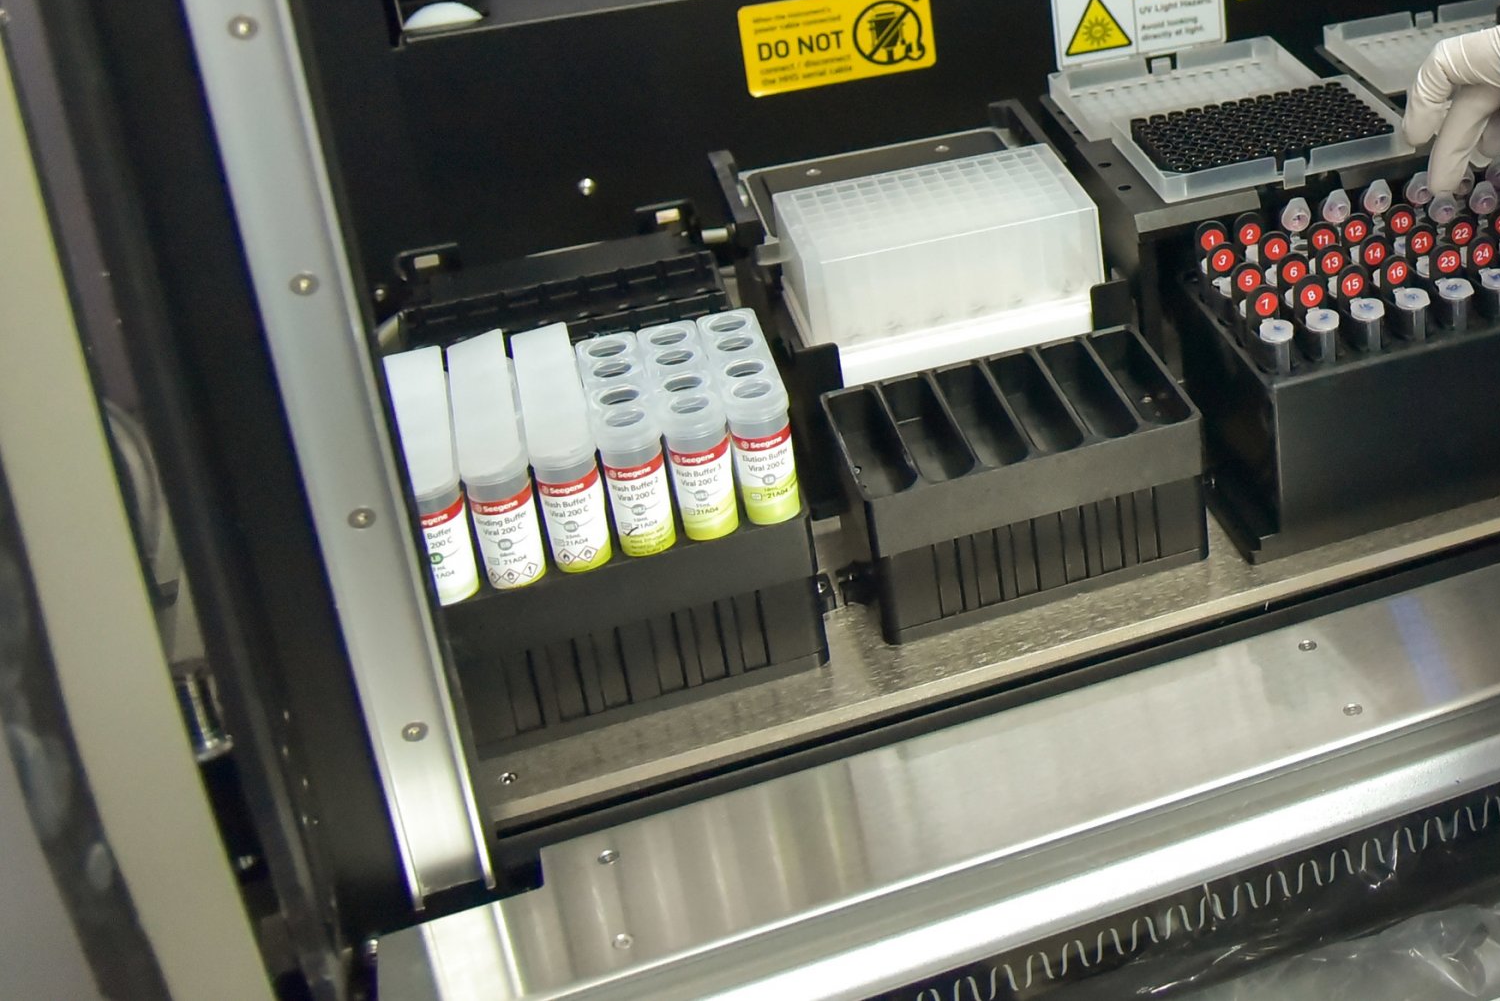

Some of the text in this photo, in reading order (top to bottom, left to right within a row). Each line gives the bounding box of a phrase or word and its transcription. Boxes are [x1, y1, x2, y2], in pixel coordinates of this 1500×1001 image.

[1155, 1, 1178, 13] Light
[757, 30, 844, 62] DO NOT
[1395, 217, 1409, 228] 19
[1246, 229, 1254, 240] 2
[1349, 226, 1362, 237] 12
[1455, 228, 1469, 239] 22
[1208, 235, 1215, 243] 1
[1317, 235, 1329, 245] 11
[1414, 237, 1428, 248] 21
[1272, 244, 1280, 254] 4
[1368, 249, 1381, 259] 14
[1476, 248, 1489, 261] 24
[1218, 255, 1227, 266] 3
[1325, 257, 1339, 268] 13
[1441, 256, 1456, 268] 23
[1290, 266, 1298, 277] 6
[1391, 267, 1404, 278] 16
[1245, 275, 1253, 286] 5
[1346, 279, 1360, 290] 15
[1307, 290, 1316, 301] 8
[1261, 298, 1269, 309] 7
[750, 436, 782, 449] Seegene
[681, 453, 715, 464] Seegene
[742, 448, 788, 463] Elution Buffer
[694, 466, 716, 477] Buffer
[748, 464, 765, 472] Viral
[767, 461, 780, 471] 200
[617, 466, 652, 479] Seegene
[631, 480, 654, 493] Buffer
[680, 479, 697, 487] Viral
[698, 477, 713, 487] 200
[549, 482, 585, 495] Seegene
[766, 488, 788, 499] 21A04
[617, 494, 634, 502] Viral
[635, 491, 650, 501] 200
[482, 500, 519, 513] Seegene
[562, 497, 586, 508] Buffer
[550, 510, 566, 518] Viral
[567, 508, 583, 518] 200
[696, 506, 719, 516] 21A04
[422, 513, 449, 526] egene
[504, 511, 527, 525] Buffer
[426, 527, 452, 540] Buffer
[482, 528, 500, 536] Viral
[501, 526, 517, 536] 200
[430, 539, 446, 550] 200
[503, 554, 527, 566] 21A04
[435, 569, 455, 579] 1A04
